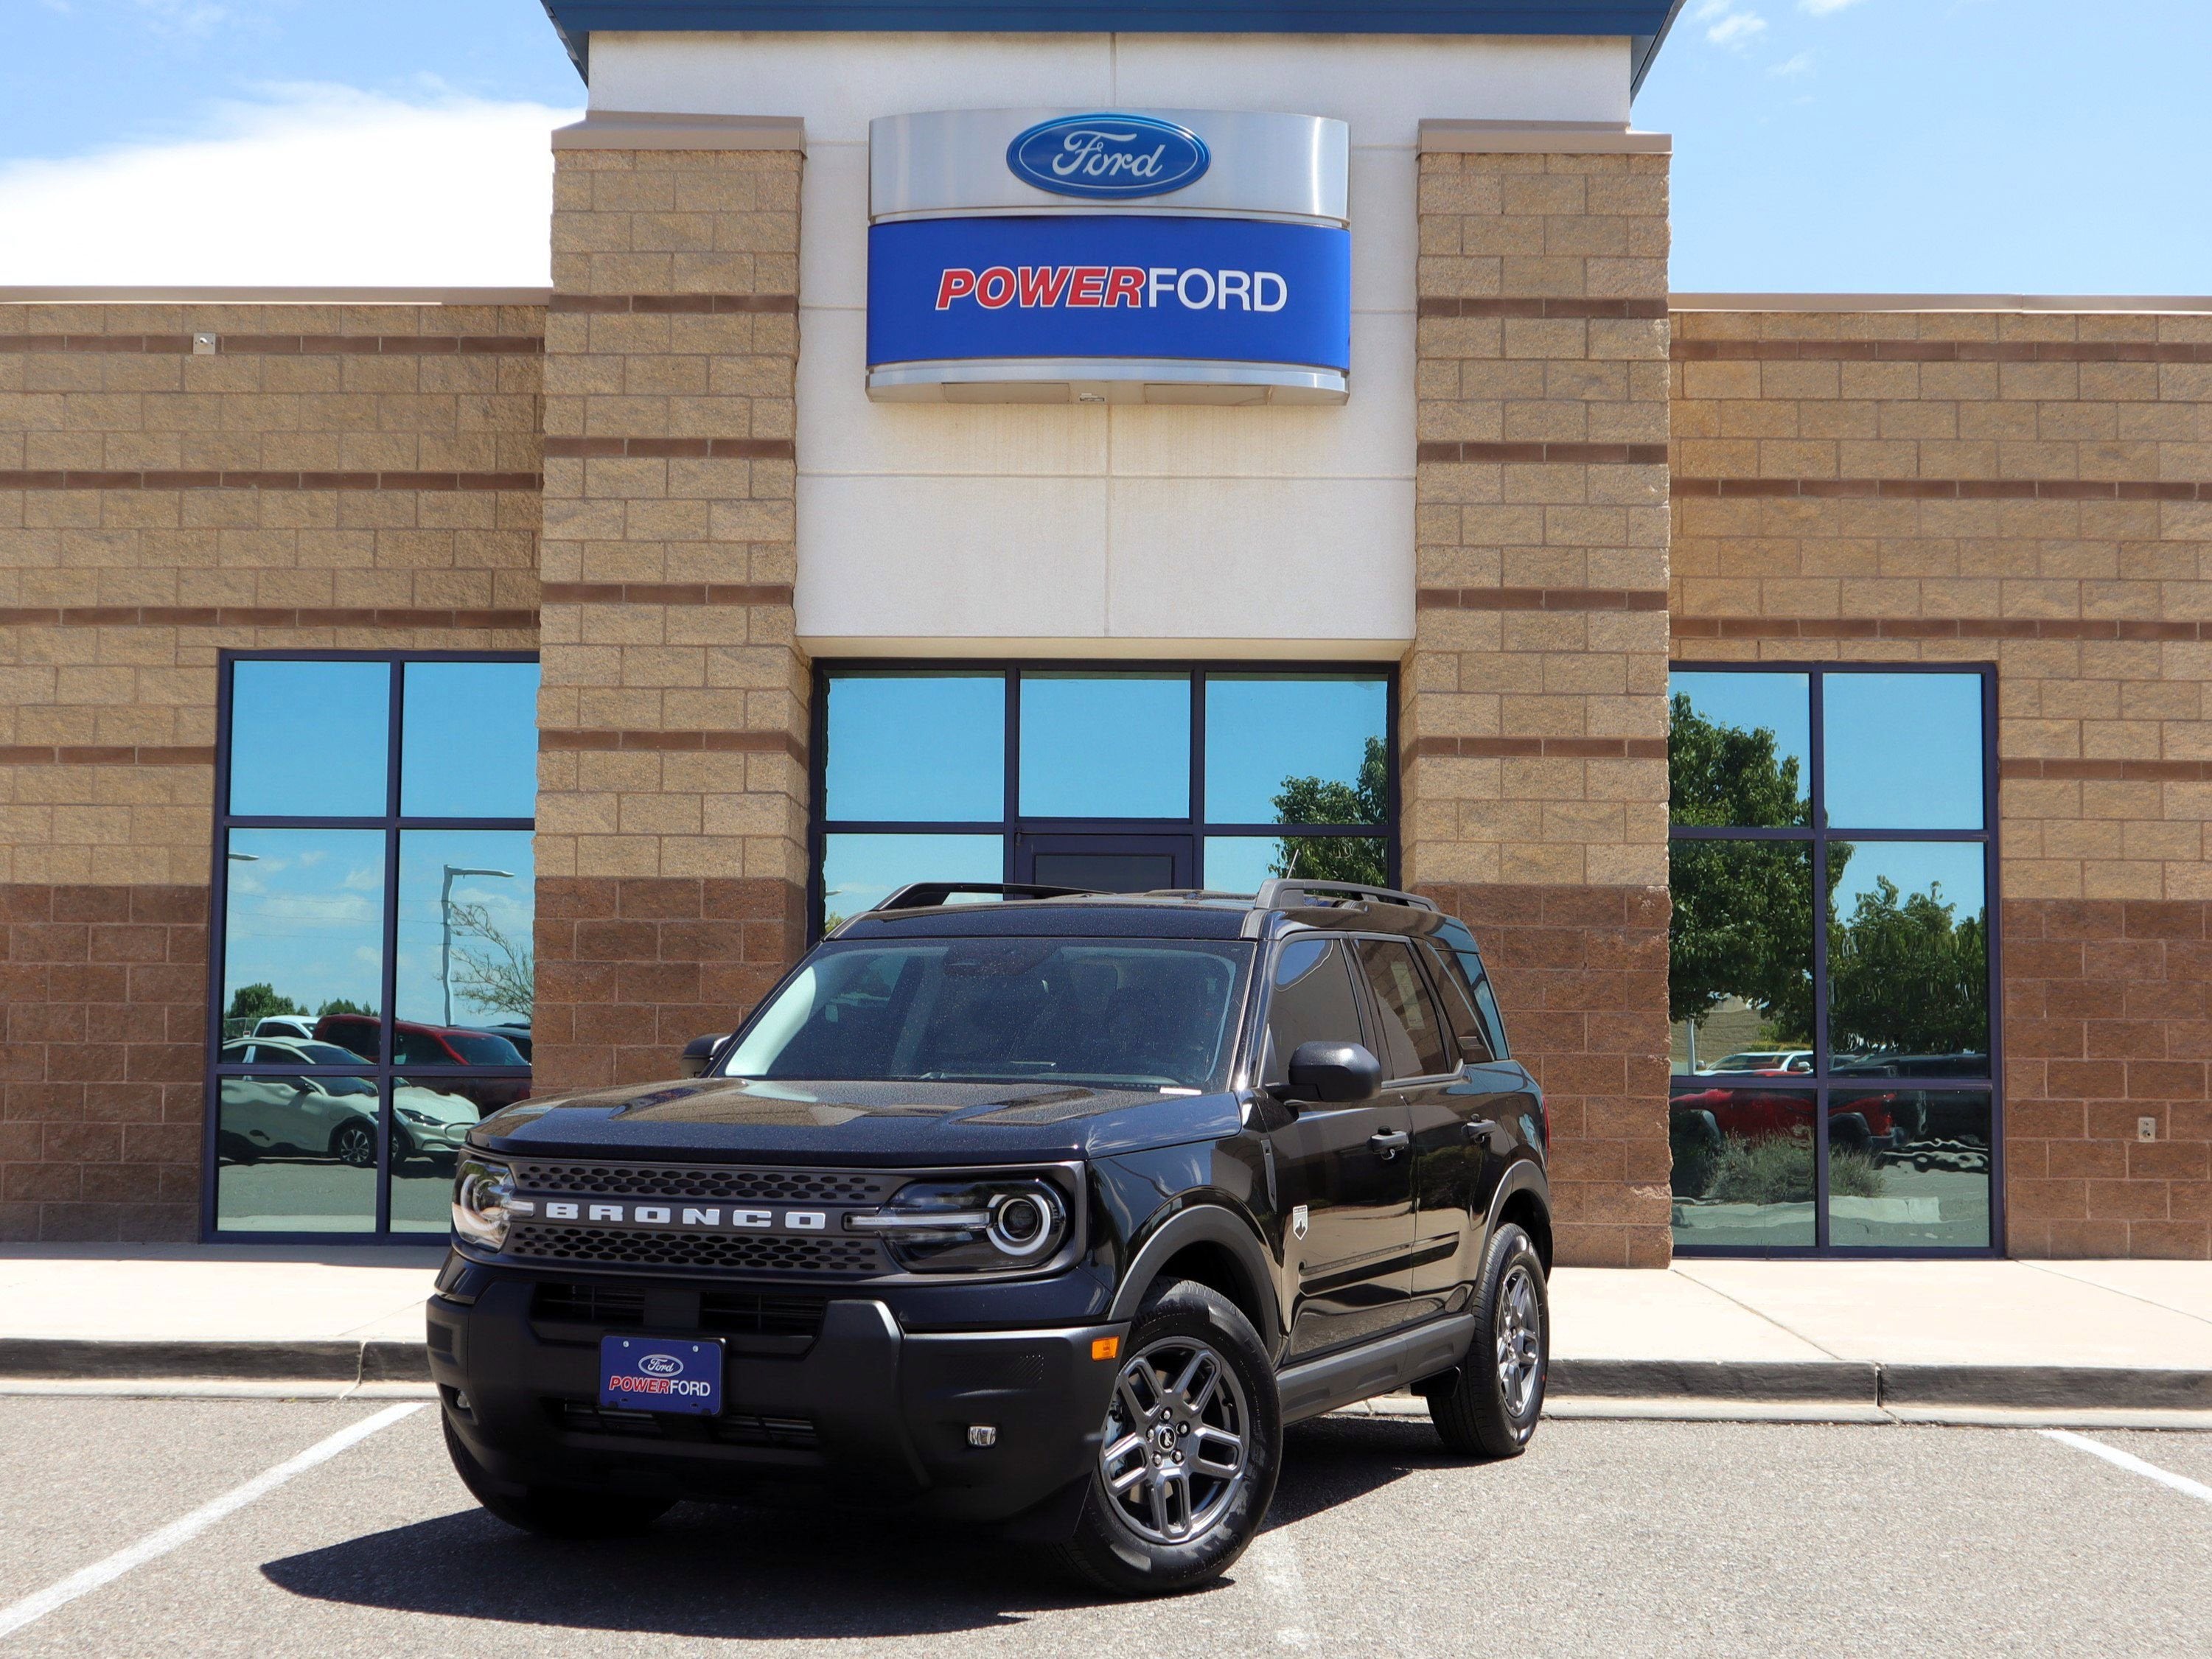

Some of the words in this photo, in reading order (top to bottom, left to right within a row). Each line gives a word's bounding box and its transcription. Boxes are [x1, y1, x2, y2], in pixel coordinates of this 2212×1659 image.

[1052, 130, 1165, 178] Ford
[545, 1202, 826, 1230] BRONCO
[647, 1358, 674, 1372] Ford
